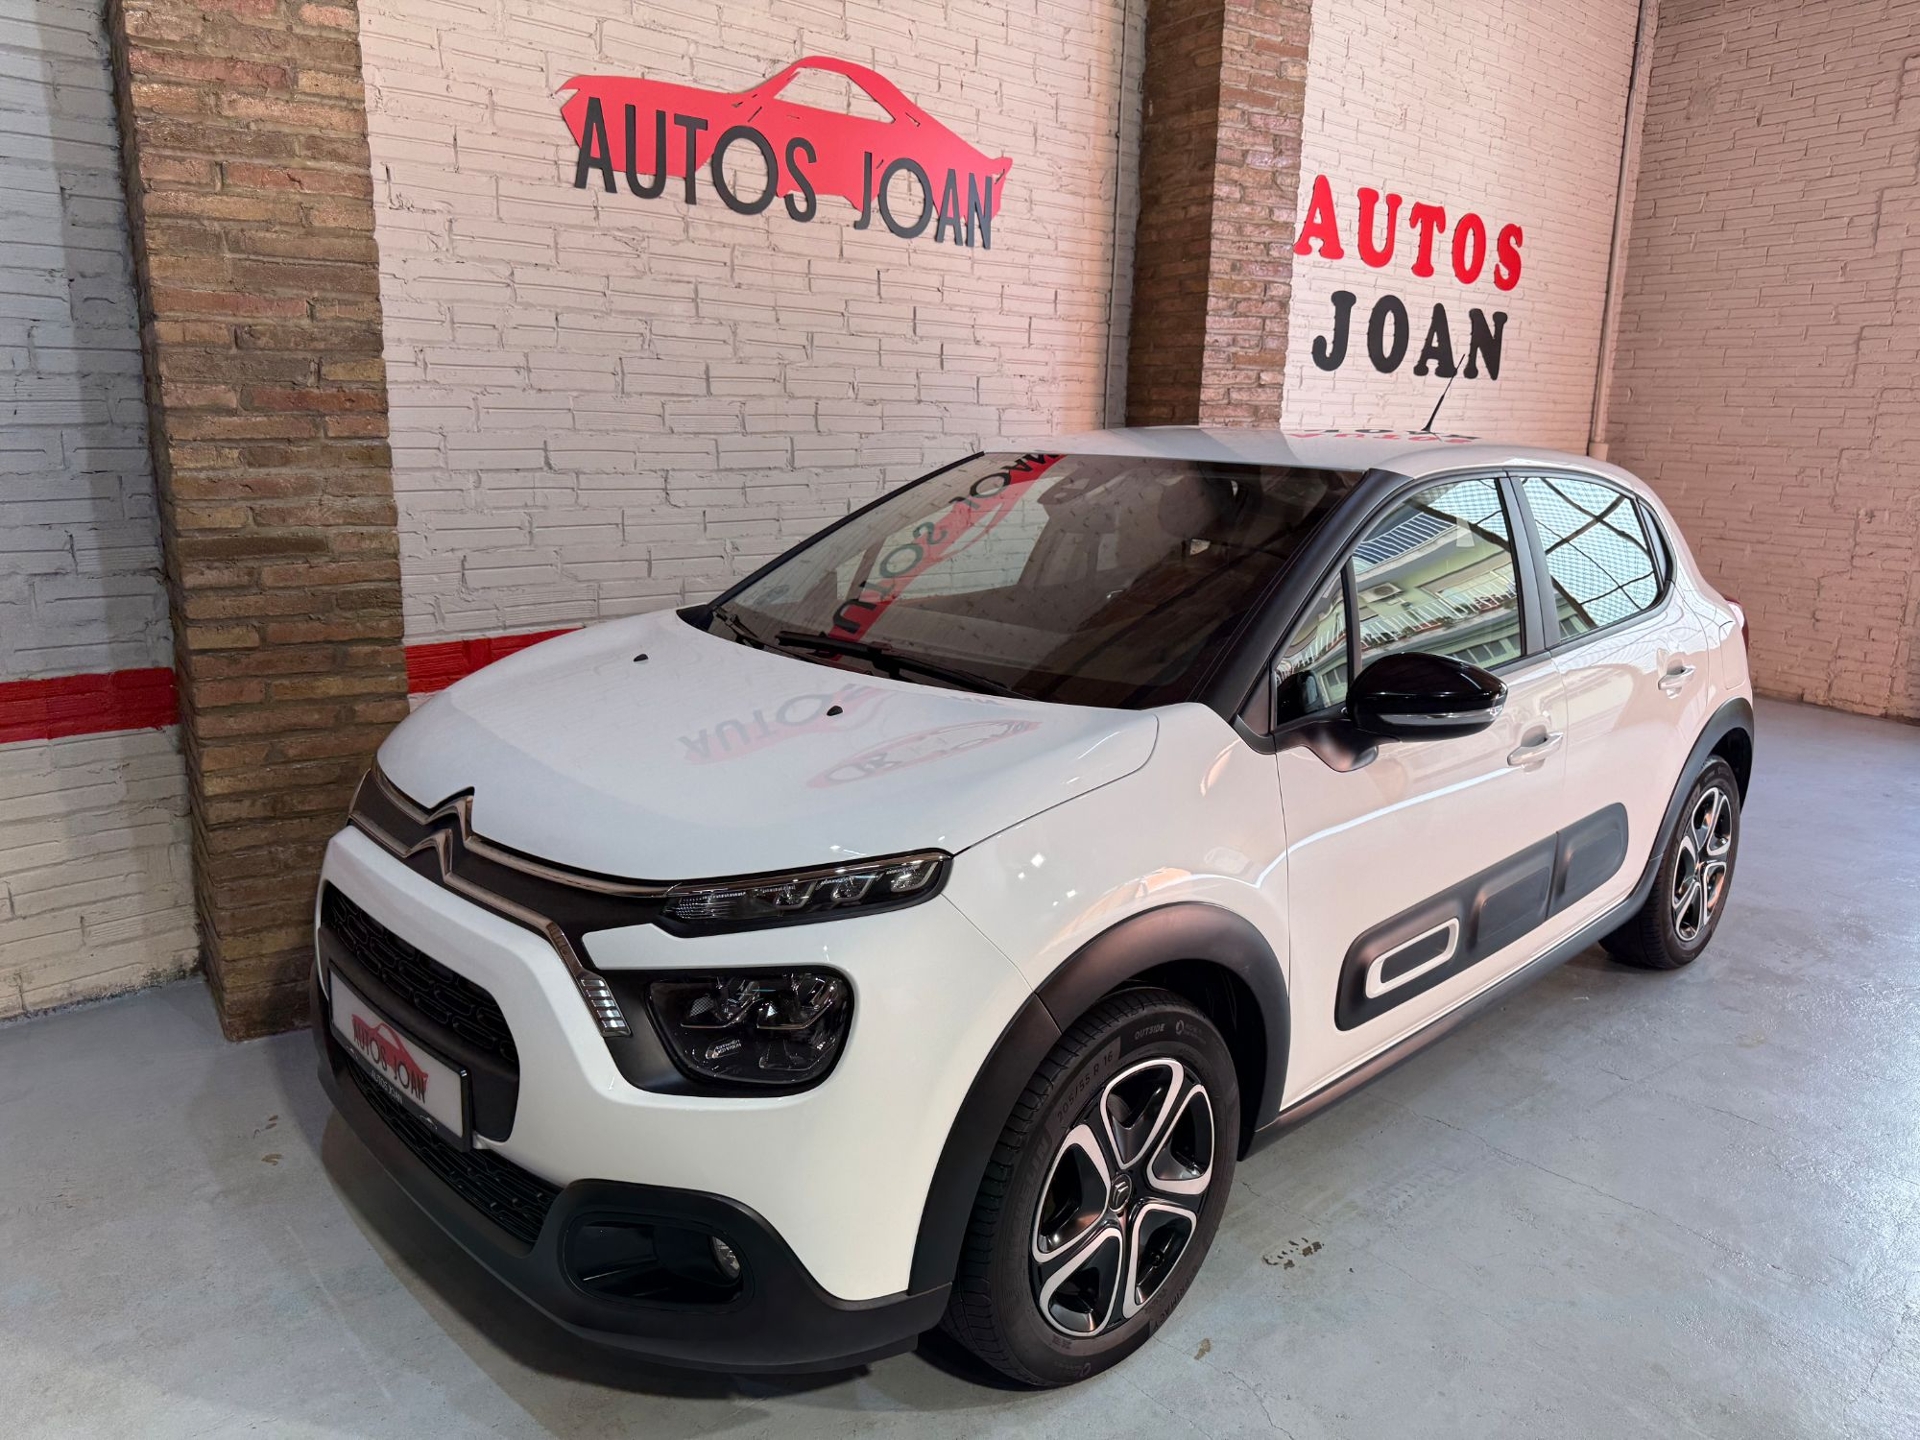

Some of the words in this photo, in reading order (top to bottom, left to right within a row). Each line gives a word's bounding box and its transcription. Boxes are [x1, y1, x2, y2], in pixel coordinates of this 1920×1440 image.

[574, 96, 817, 223] AUTOS
[853, 151, 993, 250] JOAN
[1293, 174, 1523, 292] AUTOS
[1311, 290, 1508, 381] JOAN
[353, 1022, 388, 1072] AUTOS
[393, 1054, 426, 1105] JOAN
[1134, 1023, 1166, 1040] OUTSIDE
[1057, 1074, 1091, 1119] 205/55
[1093, 1063, 1100, 1077] R
[1103, 1050, 1113, 1067] 16
